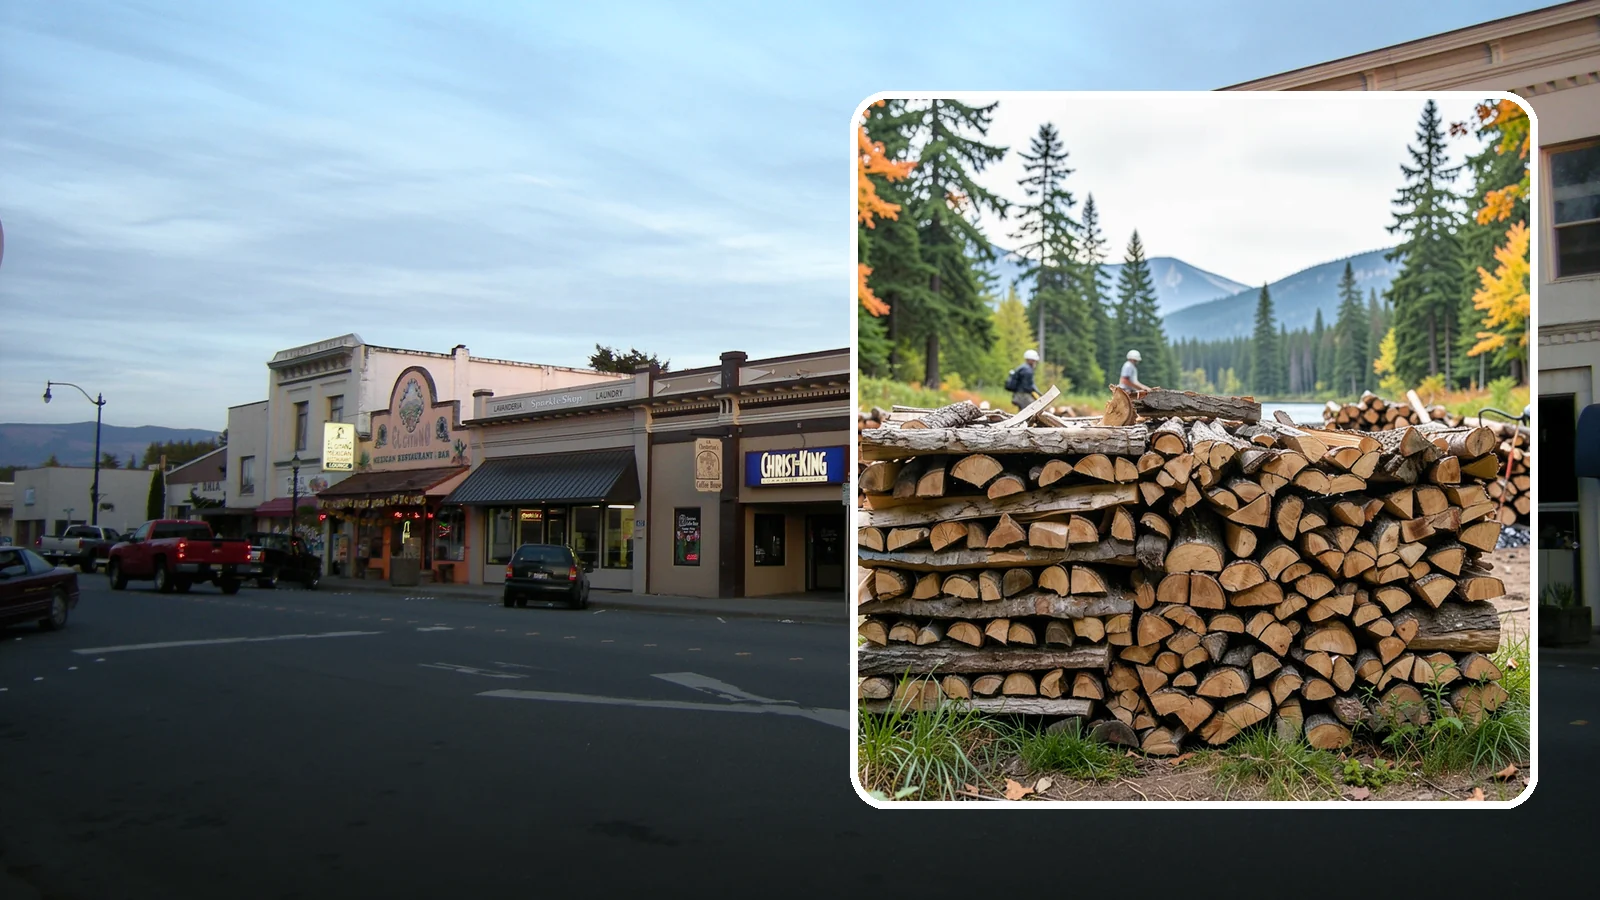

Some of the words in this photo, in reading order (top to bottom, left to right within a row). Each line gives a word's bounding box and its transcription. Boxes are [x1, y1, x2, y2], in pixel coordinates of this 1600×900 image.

[530, 398, 560, 409] Sparkle
[562, 394, 583, 406] Shop
[596, 389, 623, 400] LAUNDRY
[493, 402, 523, 412] LAVANDERIA
[392, 426, 401, 450] EL
[373, 454, 396, 464] MEXICAN
[397, 451, 433, 462] RESTAURANT
[438, 450, 450, 459] BAR
[760, 452, 796, 478] CHRIST
[798, 450, 828, 477] KING
[696, 480, 709, 489] Coffee
